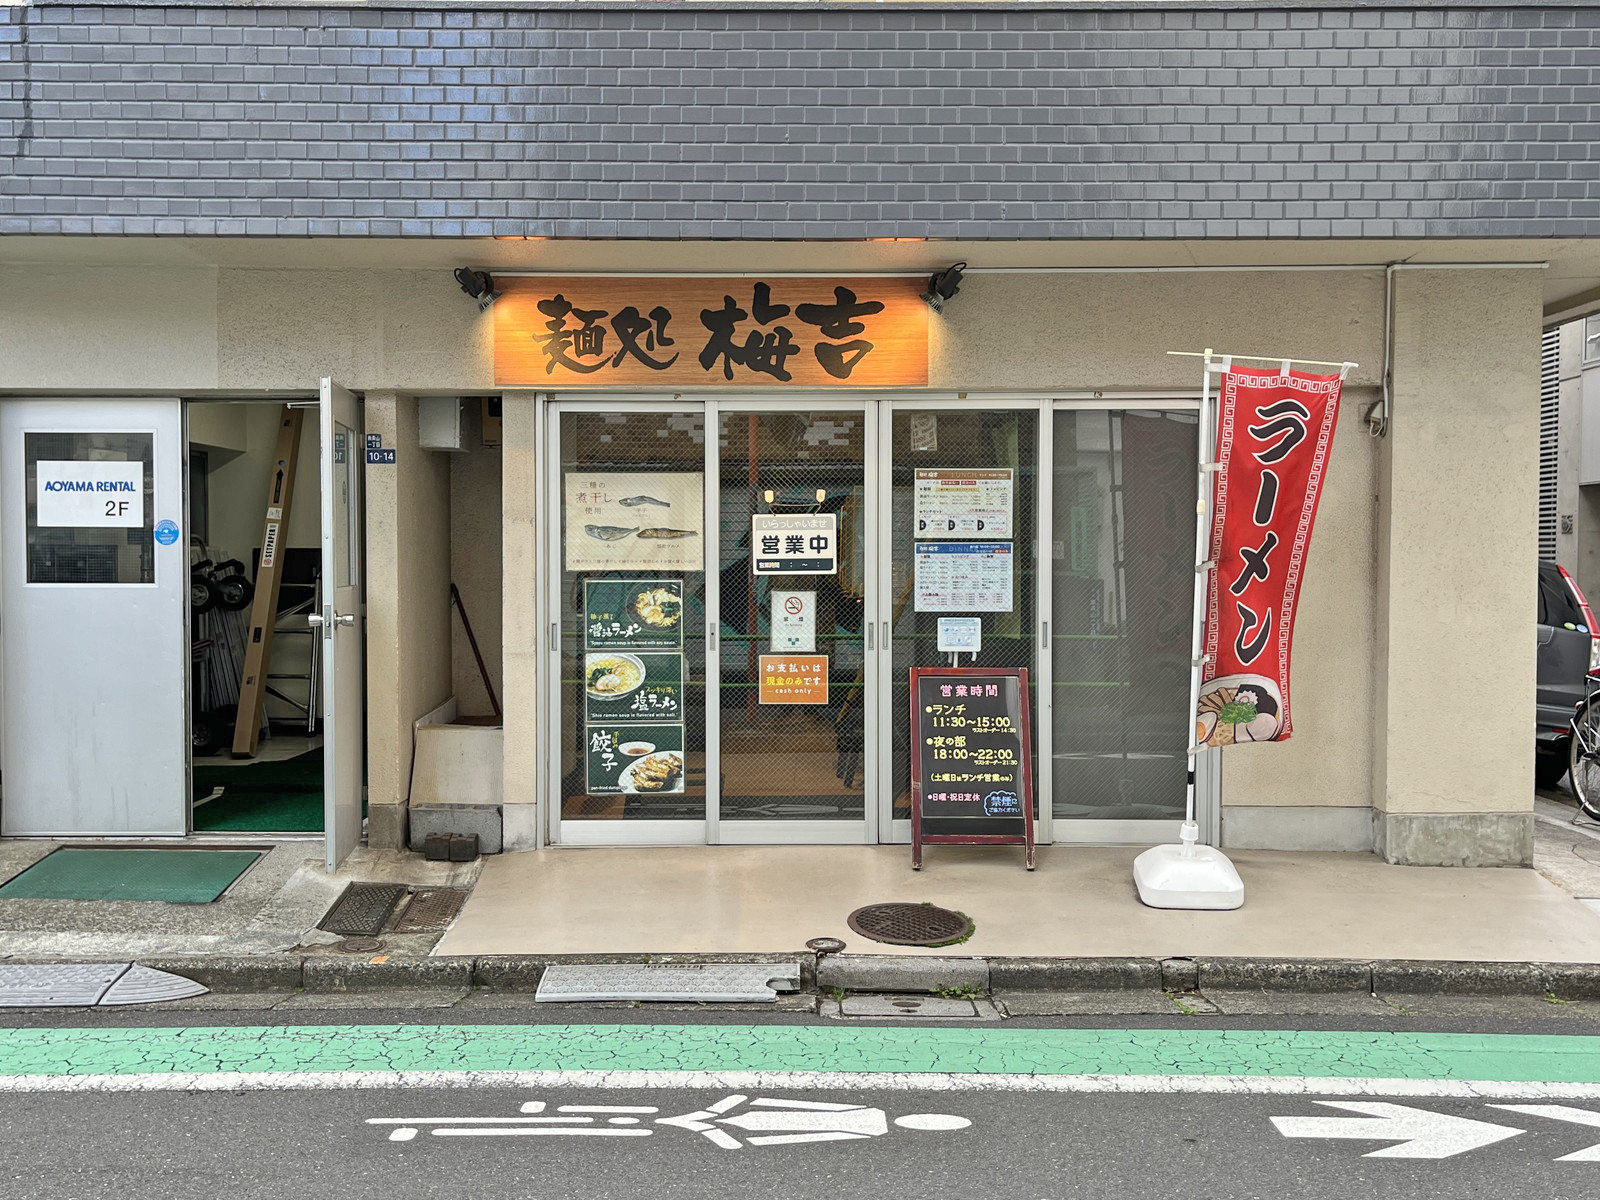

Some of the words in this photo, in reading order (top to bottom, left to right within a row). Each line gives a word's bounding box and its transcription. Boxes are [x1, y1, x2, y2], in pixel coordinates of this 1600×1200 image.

[532, 294, 680, 375] 麺処
[698, 281, 885, 381] 梅吉
[369, 452, 394, 461] 10-14
[44, 481, 94, 492] AOYAMA
[96, 481, 136, 492] RENTAL
[105, 500, 130, 516] 2F
[762, 520, 827, 529] いらっしゃいませ
[1228, 399, 1311, 667] ラーメン
[761, 534, 828, 554] 営業中
[766, 664, 821, 672] お支払いは
[766, 676, 821, 686] 現金のみです
[940, 684, 998, 697] 営業時間
[630, 690, 678, 710] 塩ラーメン
[932, 704, 966, 715] ランチ
[933, 716, 1010, 728] 11:30～15:00
[933, 736, 966, 747] 夜の部
[590, 730, 618, 772] 餃子
[934, 748, 1013, 760] 18:00～22:00
